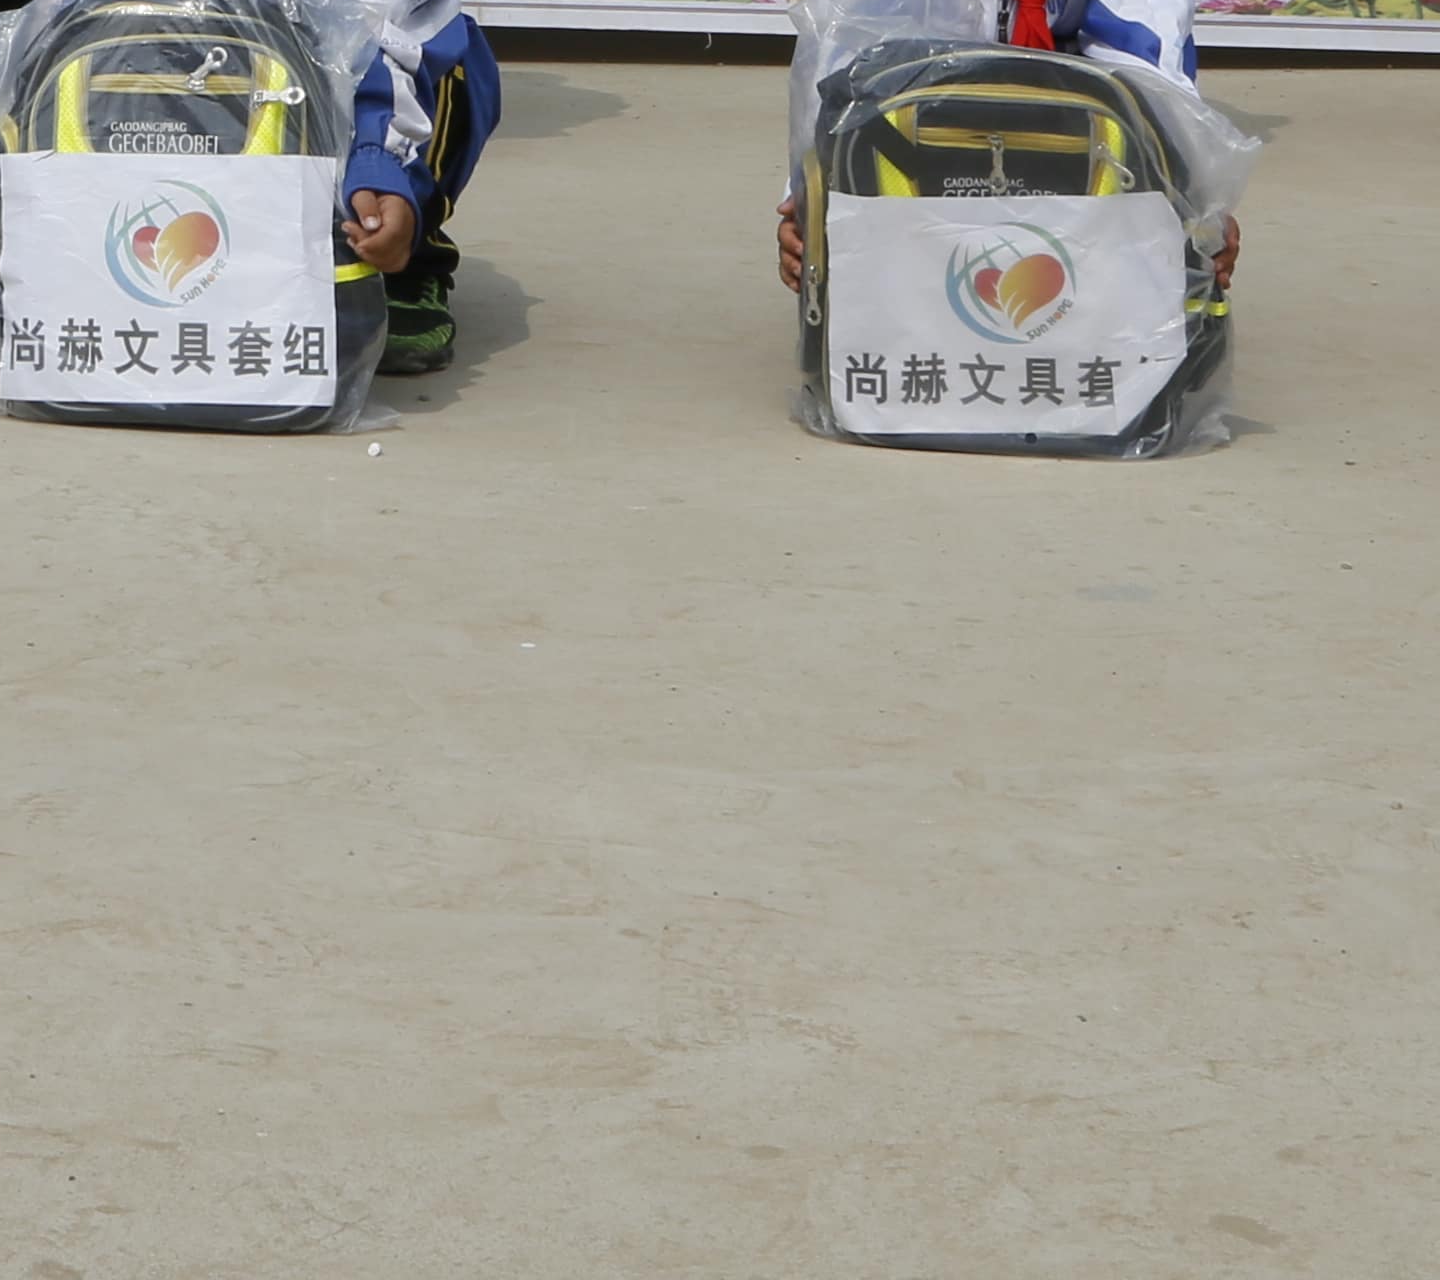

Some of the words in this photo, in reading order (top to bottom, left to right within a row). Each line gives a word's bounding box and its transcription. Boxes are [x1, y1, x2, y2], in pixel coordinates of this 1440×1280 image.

[108, 132, 219, 154] GEGEBAOBEI
[8, 317, 330, 377] 尚赫文具套组
[844, 352, 1148, 408] 尚赫文具套
